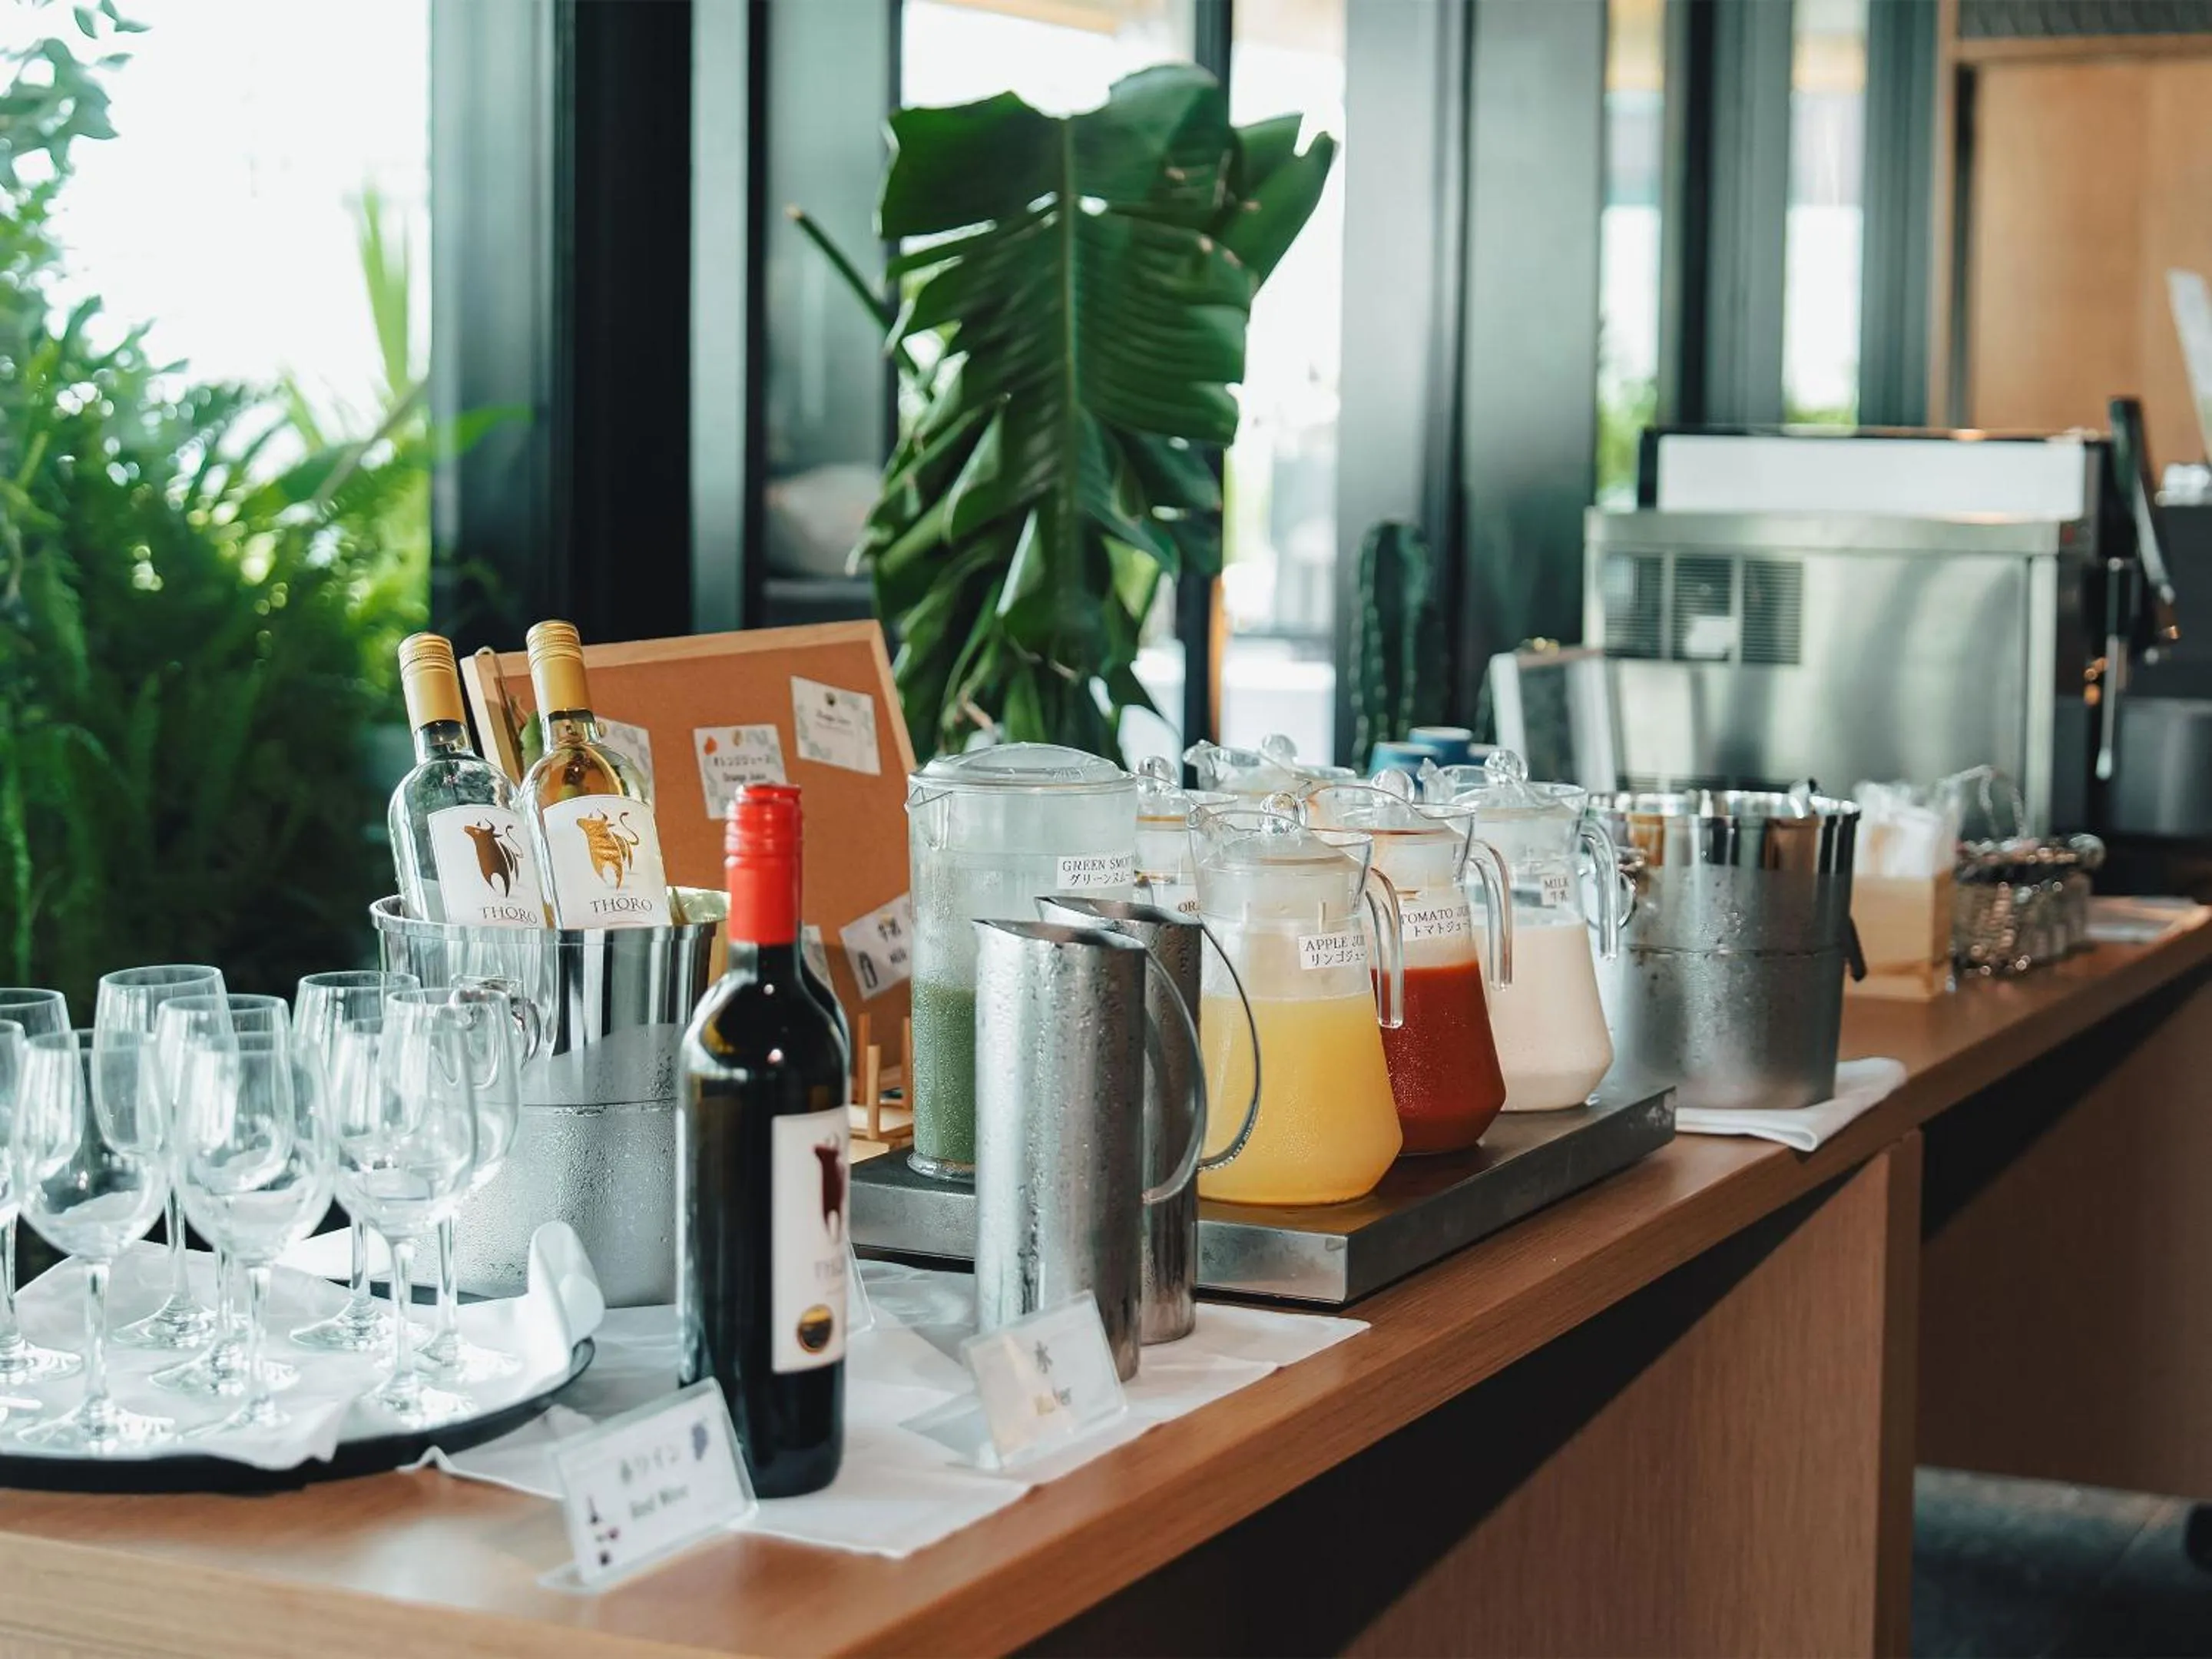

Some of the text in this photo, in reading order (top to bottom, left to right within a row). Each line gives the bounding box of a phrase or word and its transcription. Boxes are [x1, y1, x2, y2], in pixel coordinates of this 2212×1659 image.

[1062, 859, 1106, 872] GREEN
[590, 896, 652, 914] THORO
[481, 906, 538, 925] THORO
[1400, 908, 1452, 924] TOMATO
[1305, 936, 1349, 952] APPLE
